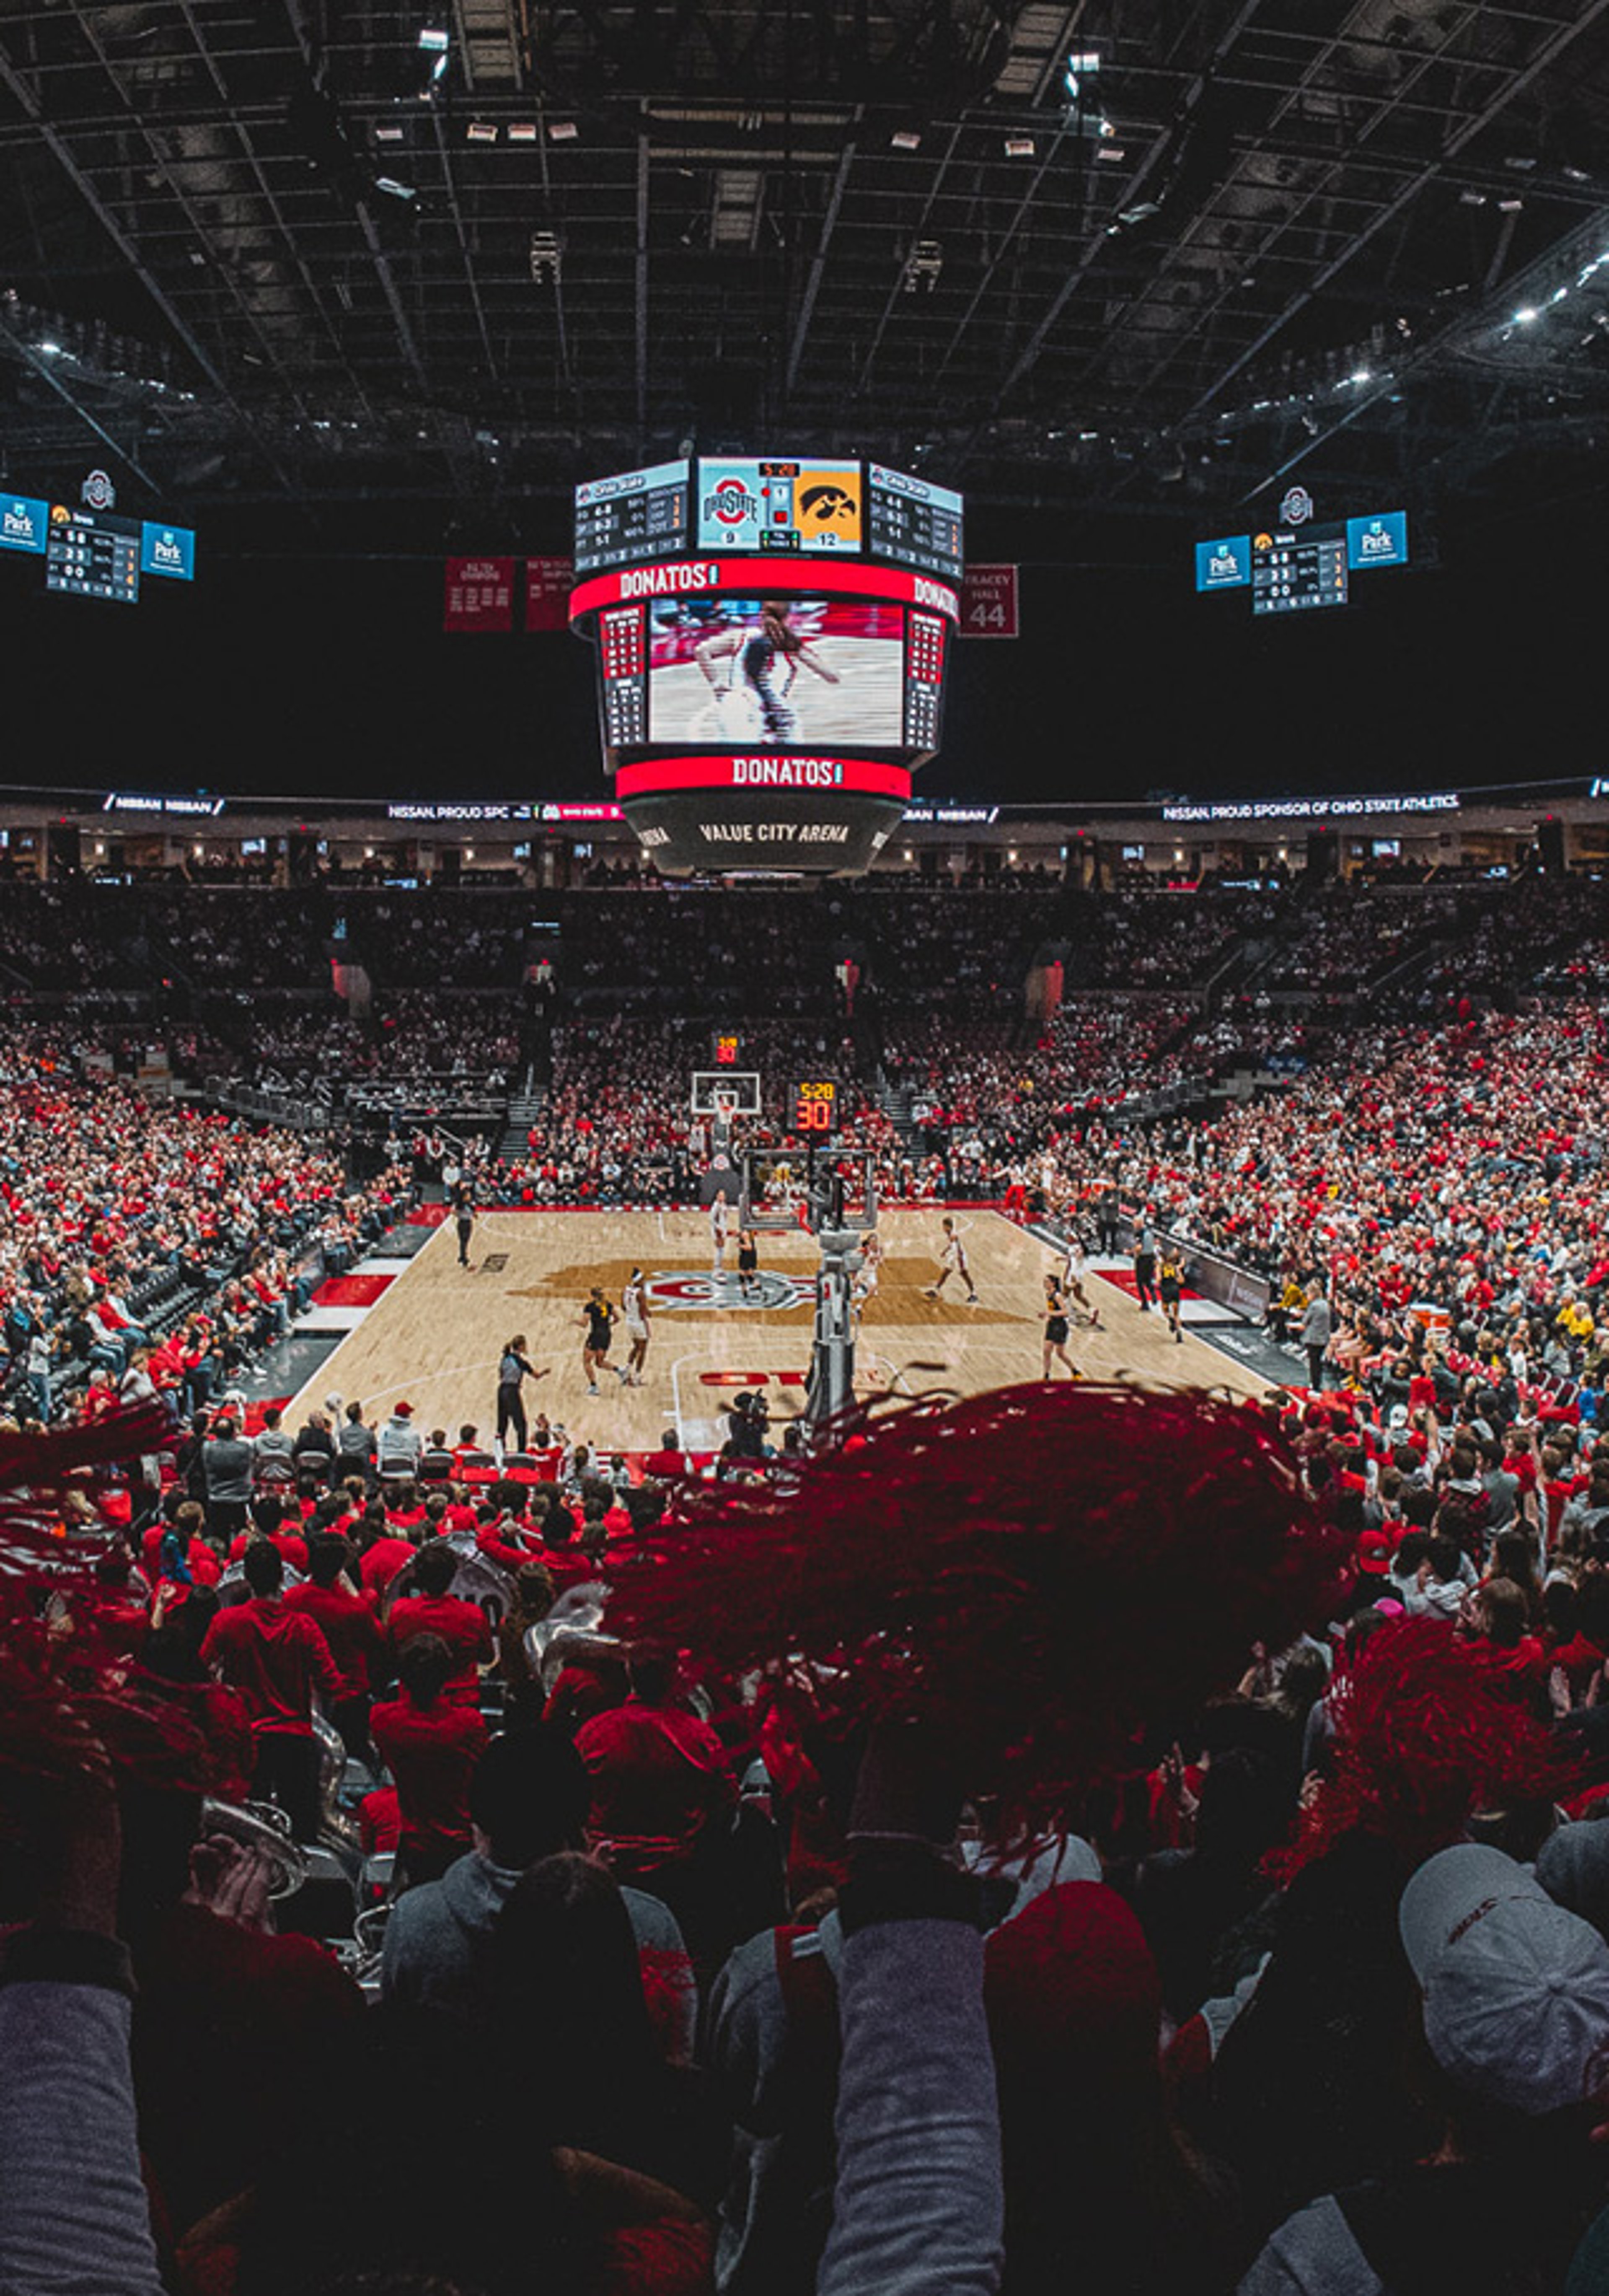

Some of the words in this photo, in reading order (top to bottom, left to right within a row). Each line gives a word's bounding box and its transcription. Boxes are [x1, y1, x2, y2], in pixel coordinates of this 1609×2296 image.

[4, 513, 34, 531] Park
[726, 531, 735, 544] 9
[819, 534, 836, 546] 12
[155, 541, 181, 560] Park
[621, 562, 706, 599] DONATOS
[969, 604, 1006, 627] 44
[732, 759, 833, 785] DONATOS
[116, 797, 162, 810] NISSAN
[166, 799, 212, 813] NISSAN
[437, 805, 481, 818] PROUD
[1211, 804, 1253, 819] PROUD
[1254, 801, 1311, 818] SPONSOR
[1312, 801, 1330, 815] OF
[1331, 800, 1363, 814] OHIO
[1364, 798, 1401, 813] STATE
[936, 809, 987, 821] NISSAN
[698, 824, 753, 842] VALUE
[758, 824, 797, 841] CITY
[799, 824, 849, 843] ARENA
[800, 1083, 835, 1100] 5:28
[797, 1099, 830, 1131] 30
